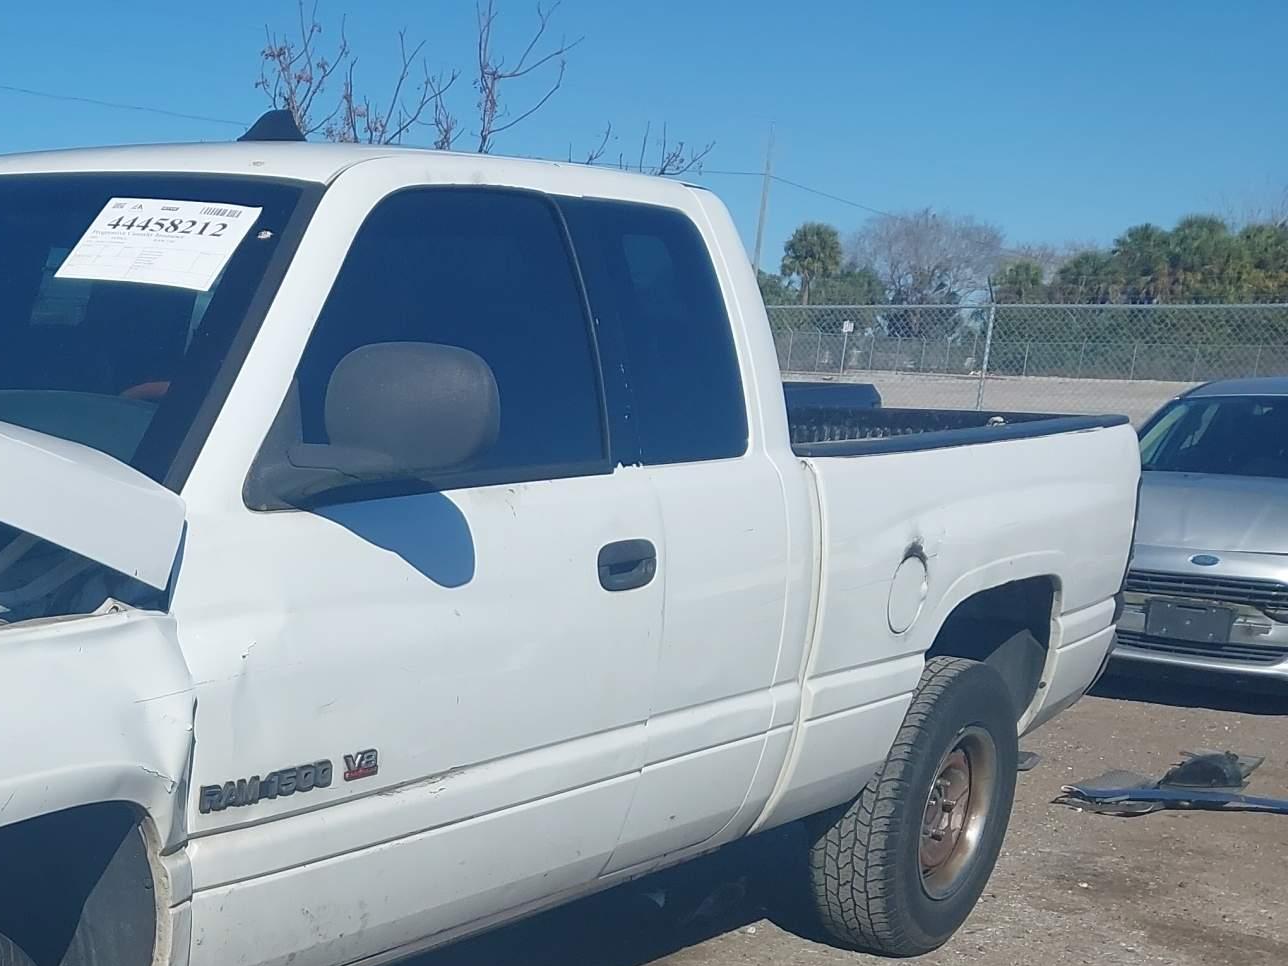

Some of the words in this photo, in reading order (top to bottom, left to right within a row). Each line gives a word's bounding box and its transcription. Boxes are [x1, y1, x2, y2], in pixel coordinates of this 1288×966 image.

[106, 214, 229, 238] 44458212
[343, 748, 378, 773] V8
[199, 775, 260, 814] RAM
[262, 759, 333, 800] 1500
